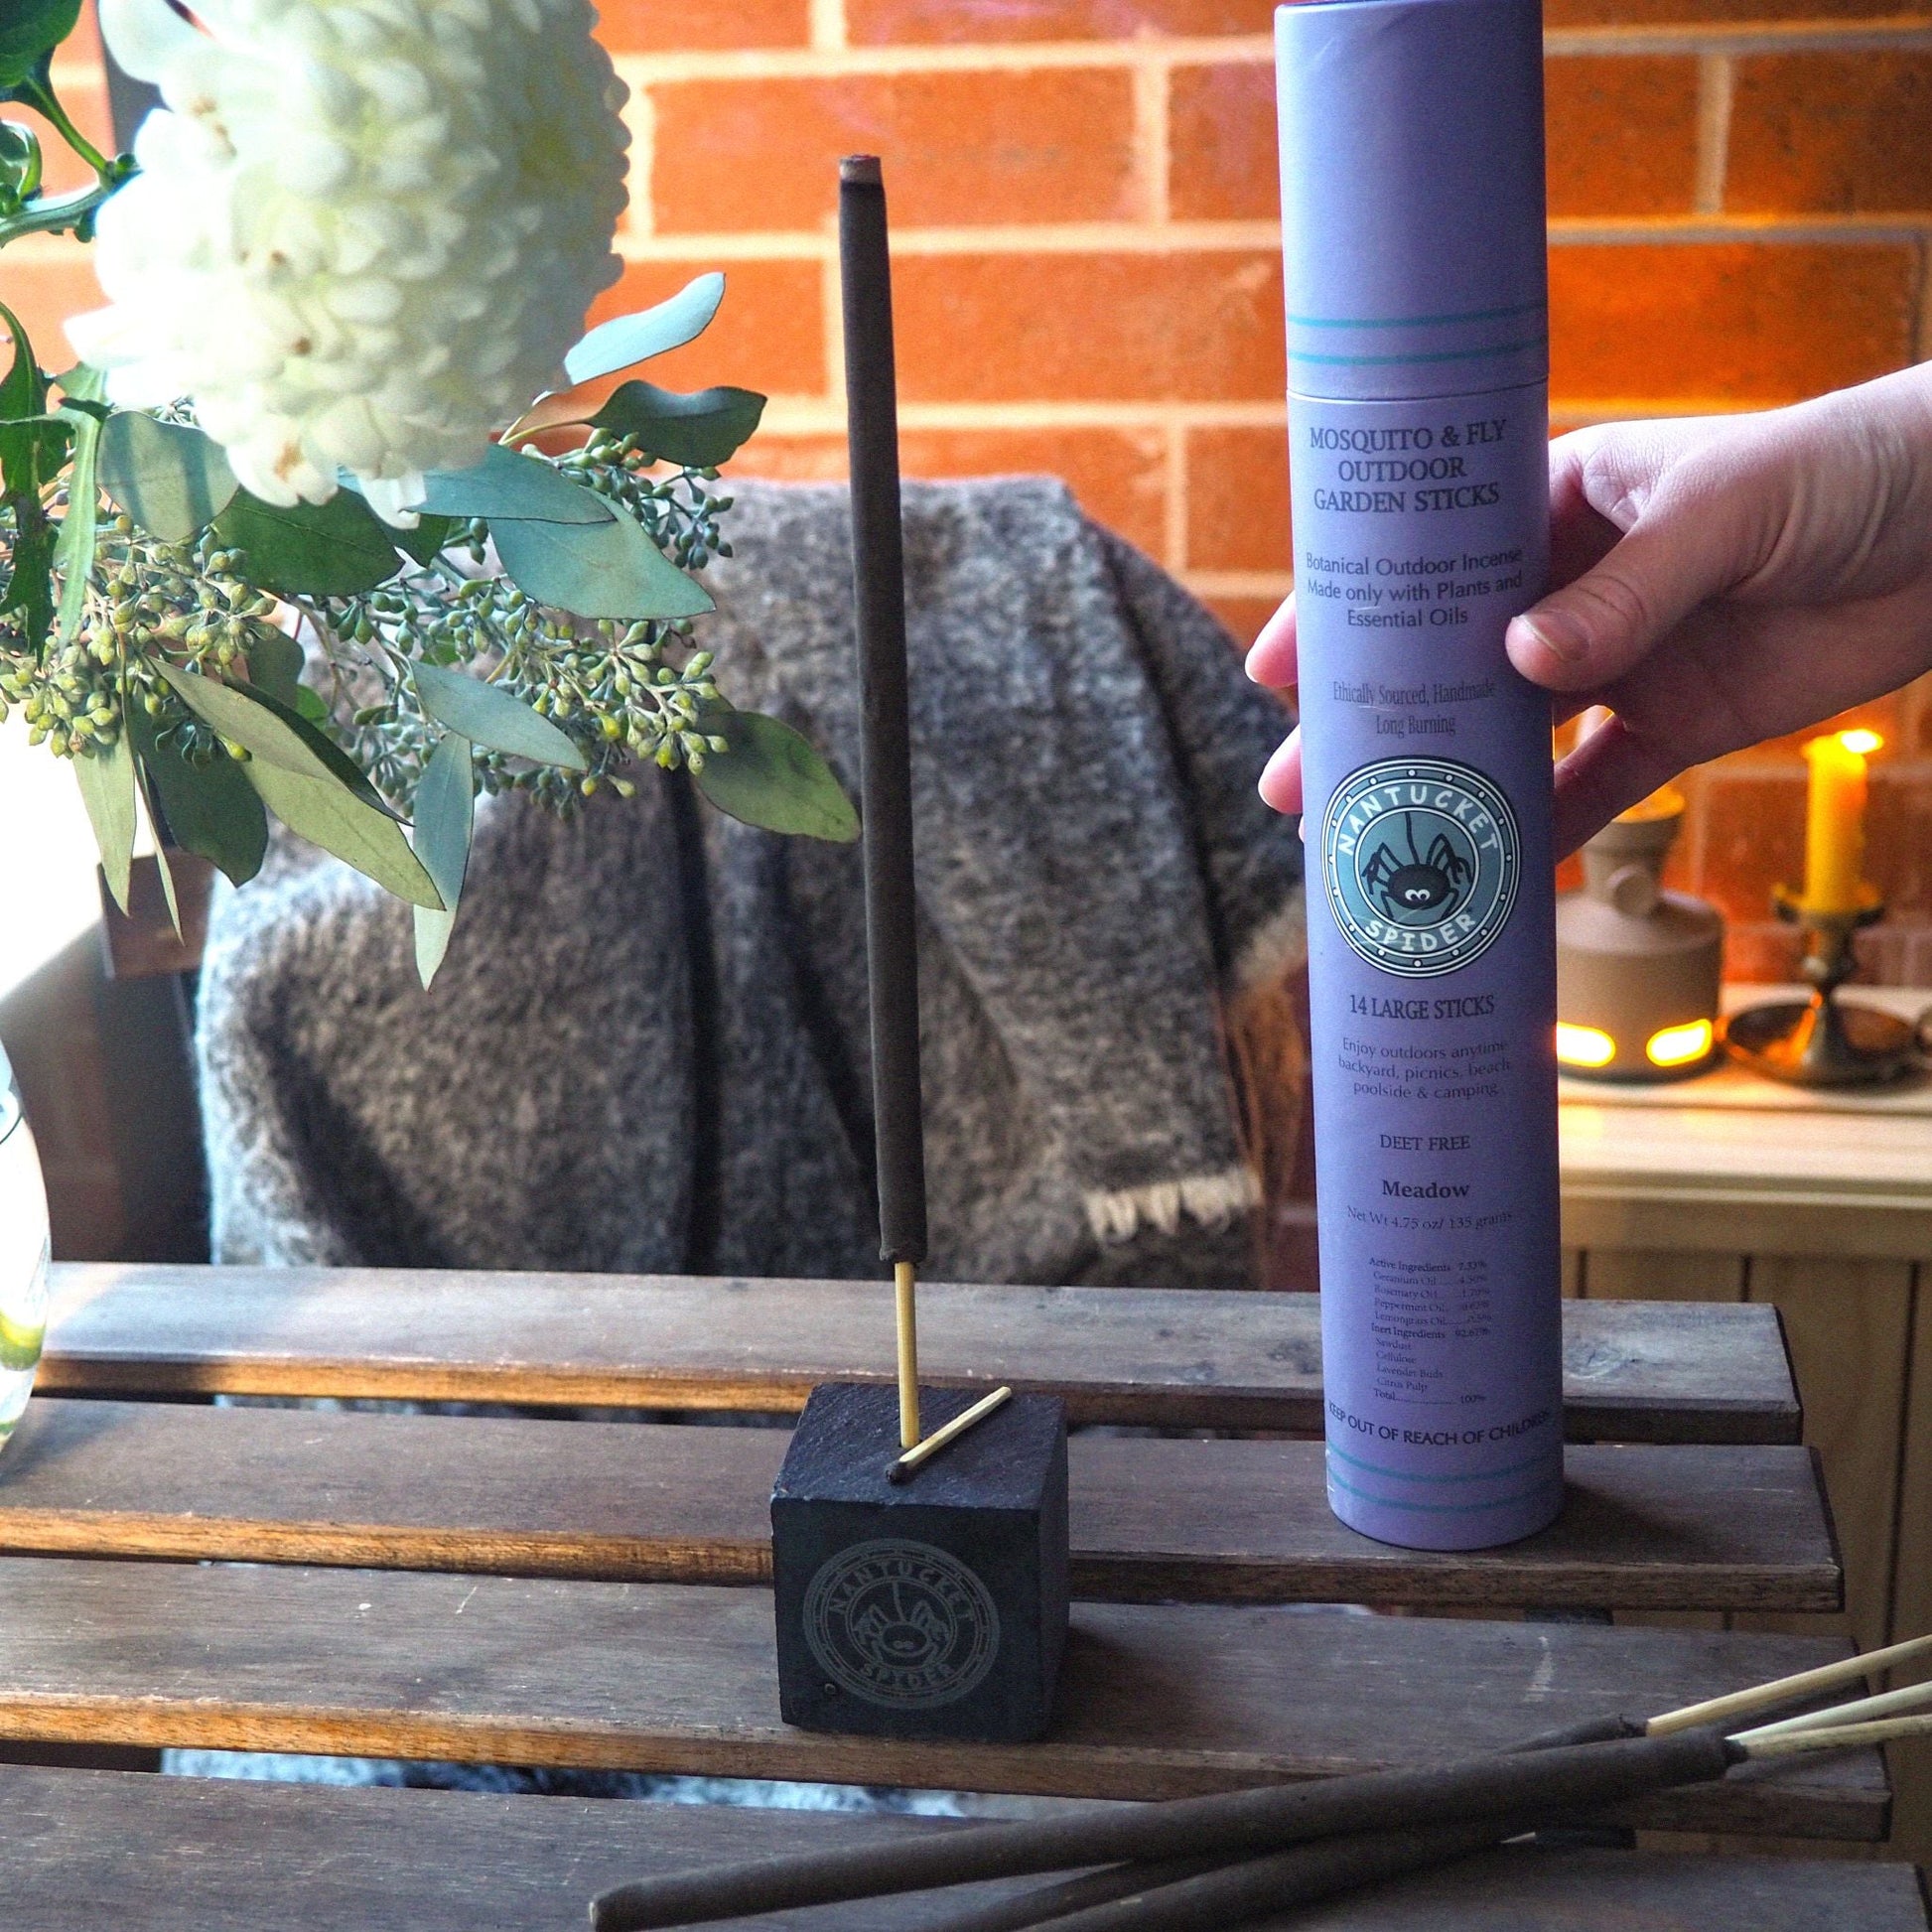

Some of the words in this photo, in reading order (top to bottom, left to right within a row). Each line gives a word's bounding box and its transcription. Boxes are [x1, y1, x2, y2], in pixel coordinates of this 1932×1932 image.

[1310, 427, 1433, 454] MOSQUITO
[1441, 425, 1459, 447] &
[1466, 419, 1506, 445] FLY
[1338, 457, 1467, 483] OUTDOOR
[1314, 488, 1406, 513] GARDEN
[1415, 482, 1500, 512] STICKS
[1307, 552, 1368, 576] Botanical
[1375, 553, 1456, 576] Outdoor
[1462, 548, 1523, 572] Incense
[1308, 579, 1340, 599] Made
[1345, 584, 1383, 607] only
[1389, 583, 1431, 603] with
[1437, 579, 1489, 599] Plants
[1495, 570, 1522, 592] and
[1347, 609, 1423, 627] Essential
[1430, 606, 1468, 626] Oils
[1333, 681, 1374, 705] Ethically
[1379, 683, 1430, 707] Sourced,
[1434, 678, 1494, 704] Handmade
[1376, 715, 1404, 739] Long
[1408, 714, 1456, 737] Burning
[1338, 784, 1499, 857] NANTUCKET
[1364, 913, 1476, 952] SPIDER
[1349, 994, 1367, 1015] 14
[1372, 997, 1430, 1020] LARGE
[1434, 995, 1495, 1020] STICKS
[1342, 1037, 1376, 1056] Enjoy
[1380, 1045, 1446, 1059] outdoors
[1338, 1055, 1400, 1079] backyard,
[1353, 1082, 1412, 1098] poolside
[1417, 1086, 1428, 1099] &
[1434, 1083, 1497, 1100] camping
[1379, 1134, 1423, 1151] DEET
[1429, 1135, 1471, 1151] FREE
[1381, 1178, 1470, 1199] Meadow
[1347, 1205, 1366, 1222] Net
[1370, 1211, 1387, 1225] Wt
[1391, 1217, 1418, 1230] 4.75
[1449, 1217, 1472, 1229] 135
[1369, 1257, 1397, 1269] Active
[1398, 1260, 1451, 1274] Ingredients
[1393, 1326, 1446, 1339] Ingredients
[1328, 1399, 1345, 1422] KEEP
[1348, 1415, 1375, 1436] OUT
[1378, 1426, 1399, 1441] OF
[1404, 1430, 1456, 1446] REACH
[1461, 1430, 1485, 1445] OF
[829, 1560, 977, 1622] NANTUCKET
[861, 1662, 954, 1688] SPIDER
